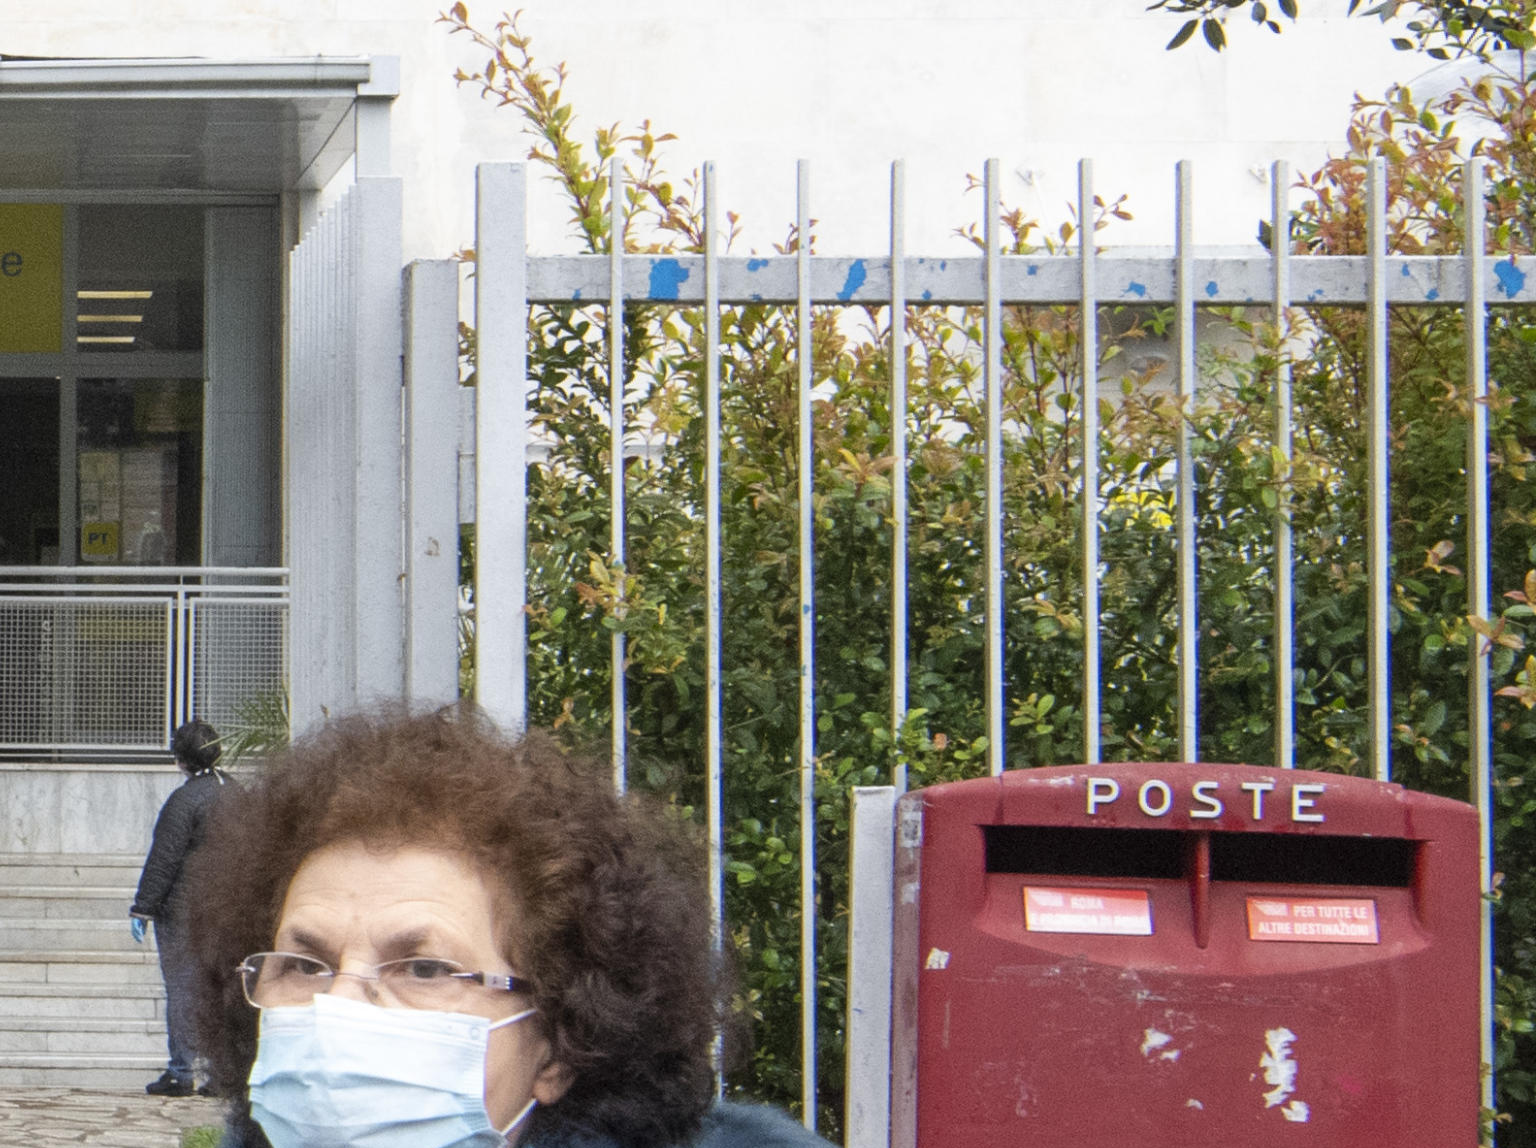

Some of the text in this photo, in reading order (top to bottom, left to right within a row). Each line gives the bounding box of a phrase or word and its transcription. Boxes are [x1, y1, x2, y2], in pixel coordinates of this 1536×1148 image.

[88, 532, 108, 544] PT
[1086, 777, 1326, 824] POSTE
[1293, 905, 1369, 919] PER TUTTE LE
[1258, 922, 1369, 936] ALTRE DESTINAZIONI
